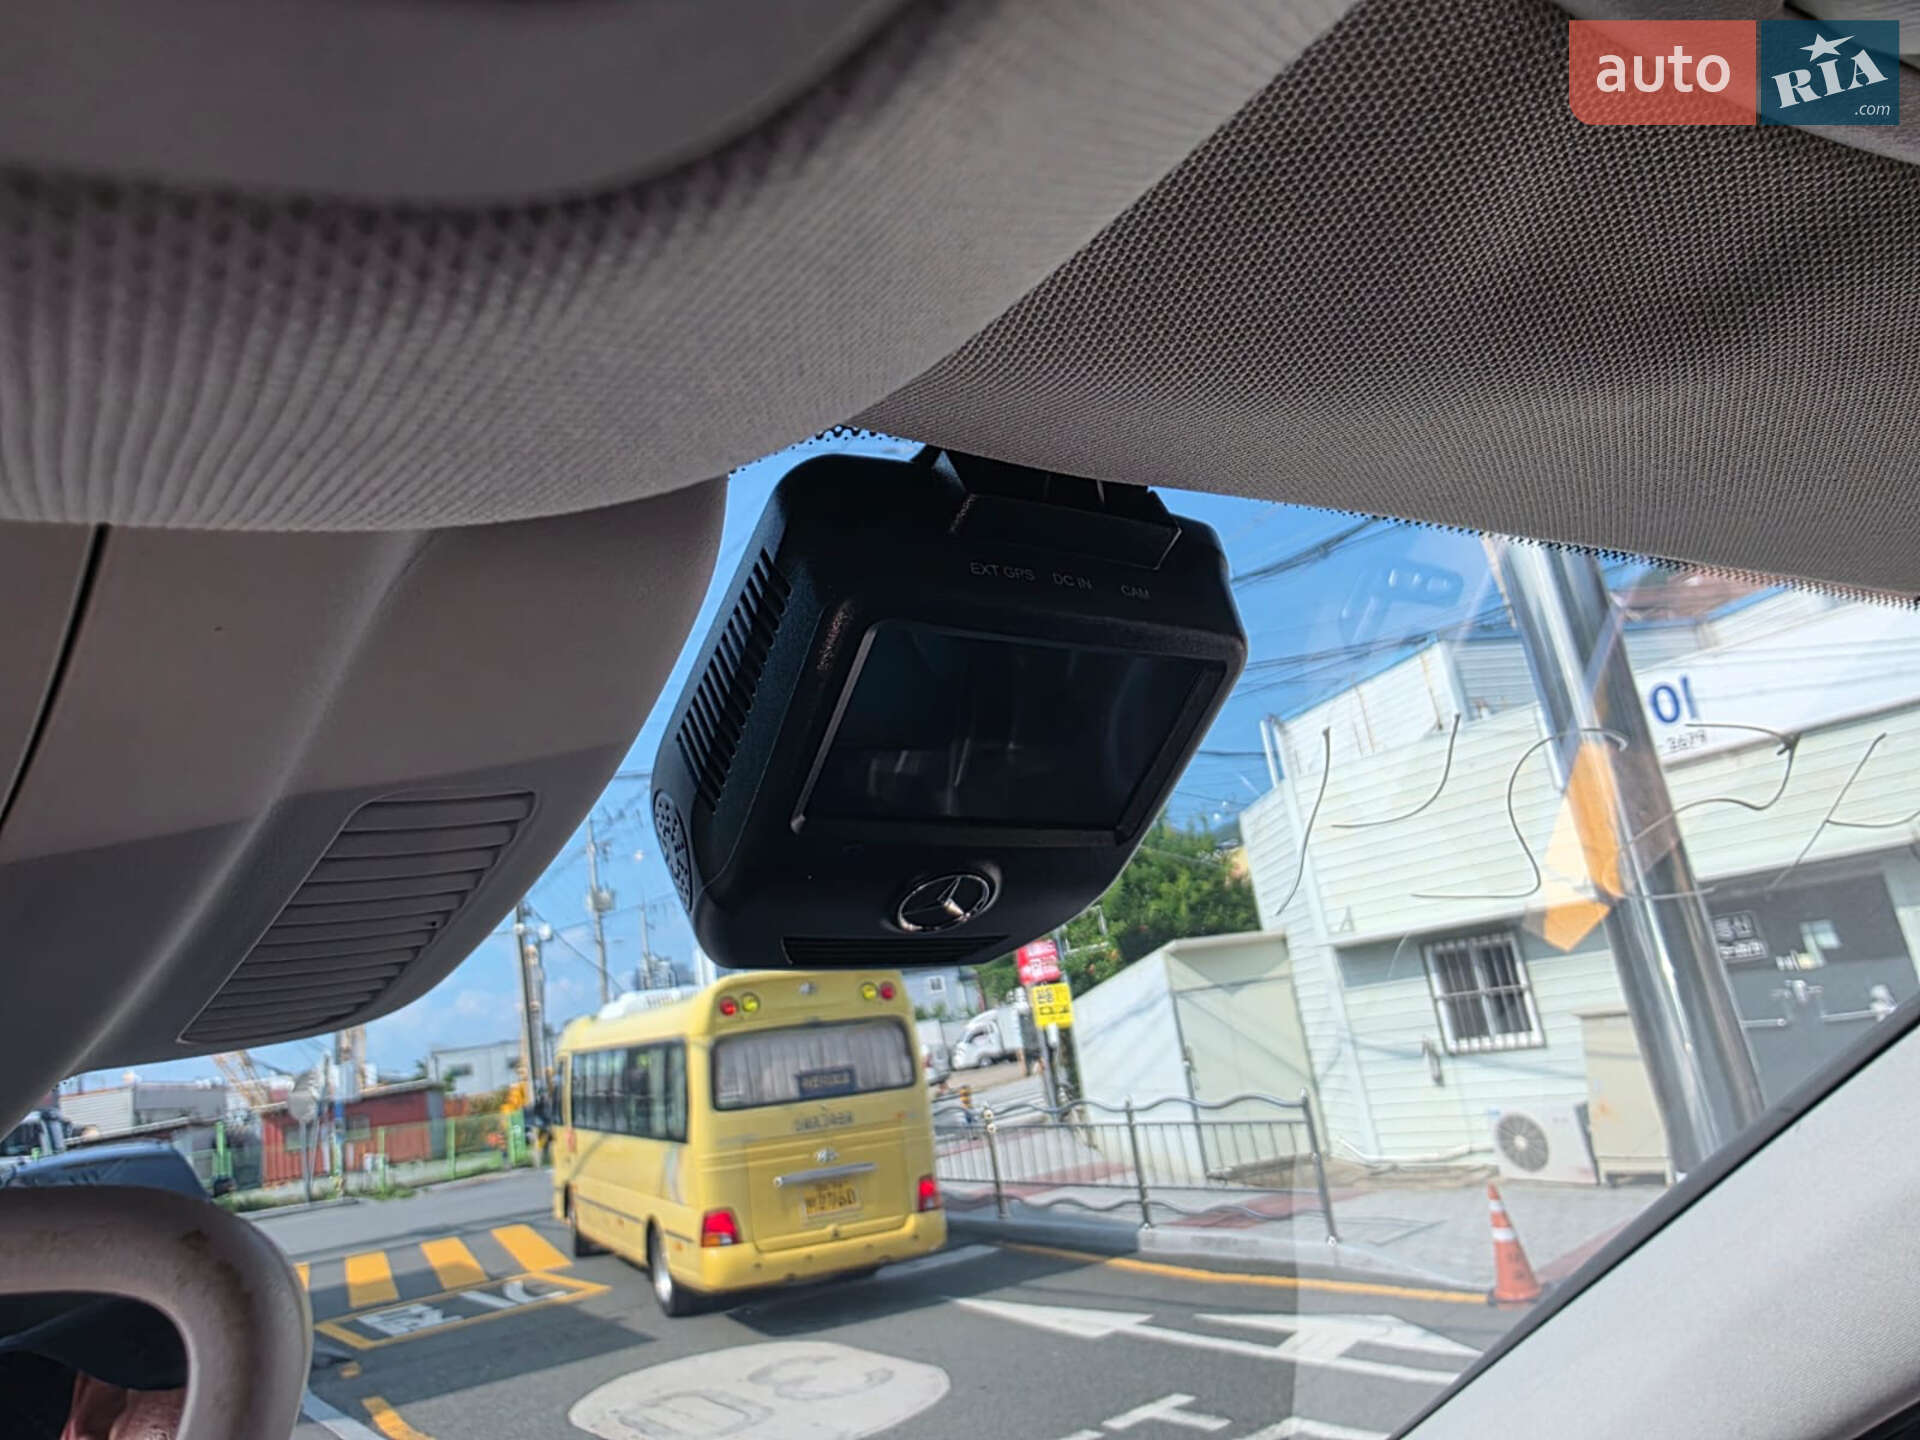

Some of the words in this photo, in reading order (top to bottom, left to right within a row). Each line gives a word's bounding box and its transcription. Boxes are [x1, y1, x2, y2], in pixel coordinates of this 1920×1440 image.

[970, 561, 999, 577] EXT
[1003, 565, 1035, 581] GPS
[1052, 572, 1075, 587] DC
[1077, 576, 1092, 590] IN
[1120, 583, 1151, 600] CAM
